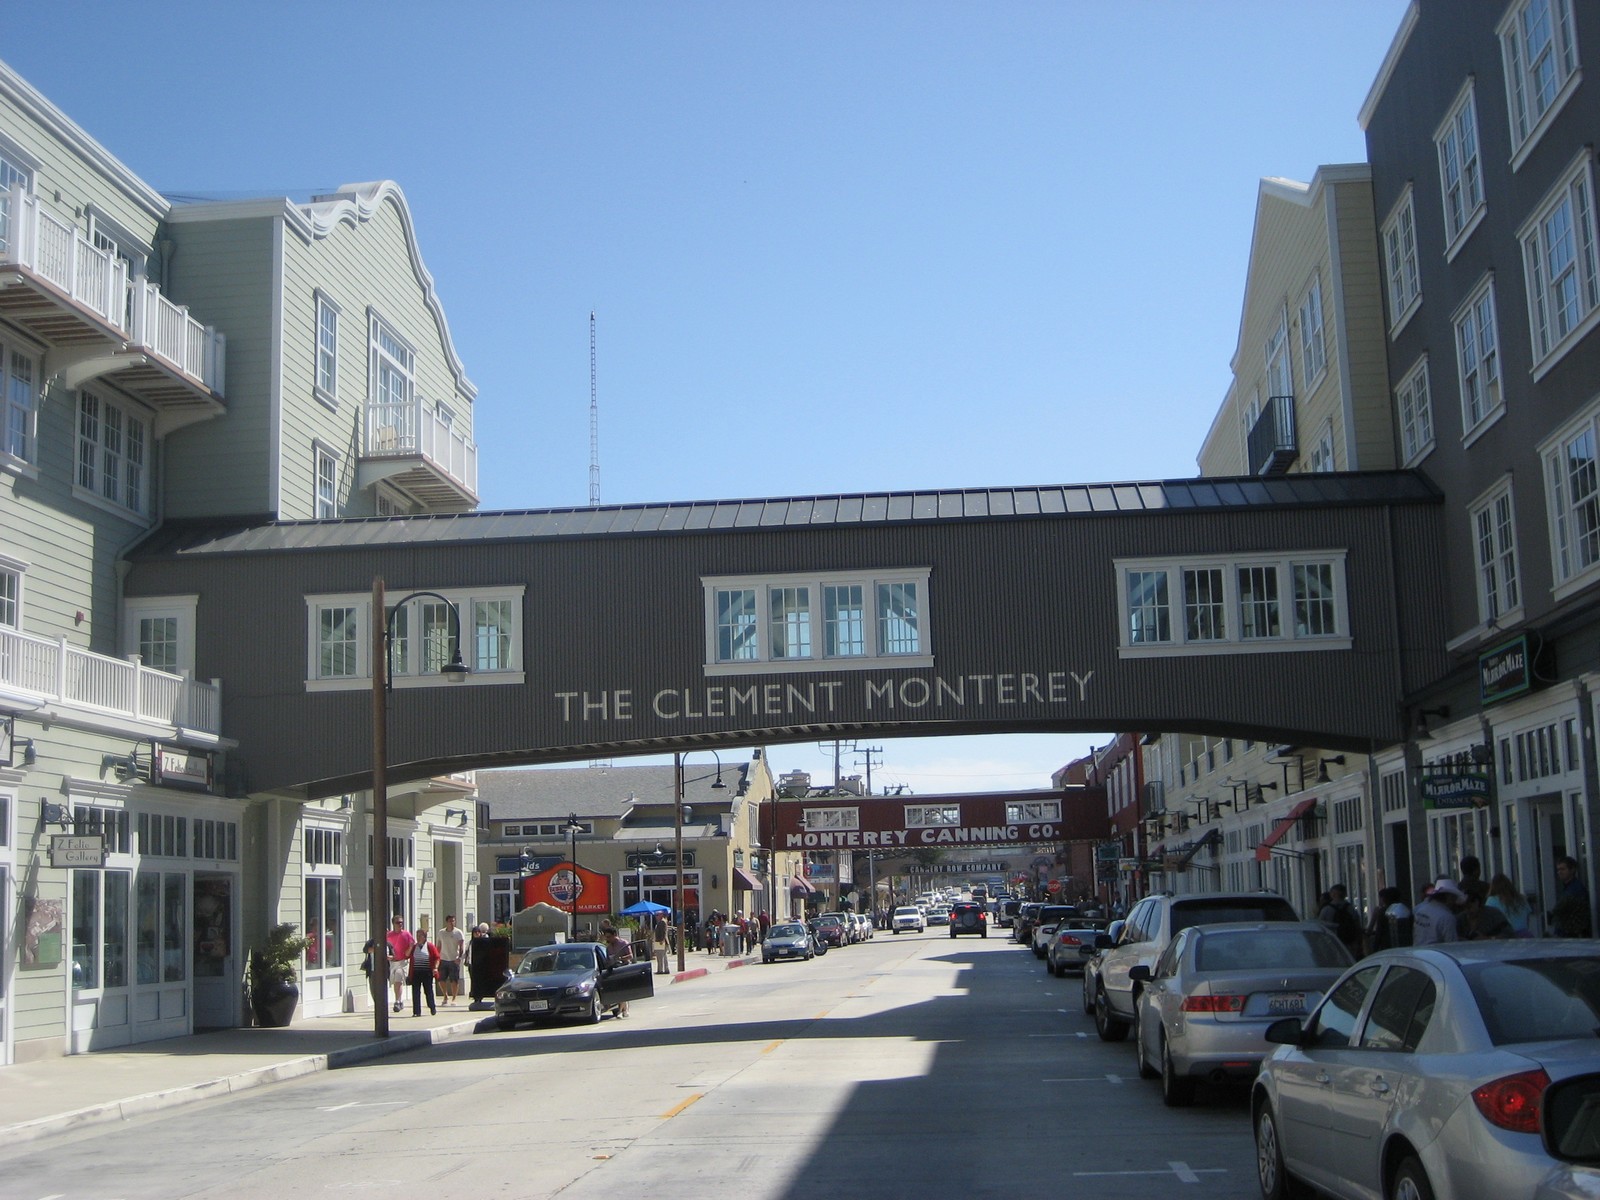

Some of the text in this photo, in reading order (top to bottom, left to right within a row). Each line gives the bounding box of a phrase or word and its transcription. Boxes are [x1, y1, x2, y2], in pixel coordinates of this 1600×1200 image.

[554, 670, 1095, 722] THE CLEMENT MONTEREY
[786, 824, 1060, 847] MONTEREY CANNING CO.
[57, 839, 90, 849] Z Folio
[65, 850, 99, 863] Gallery
[966, 863, 1001, 872] COMPANY
